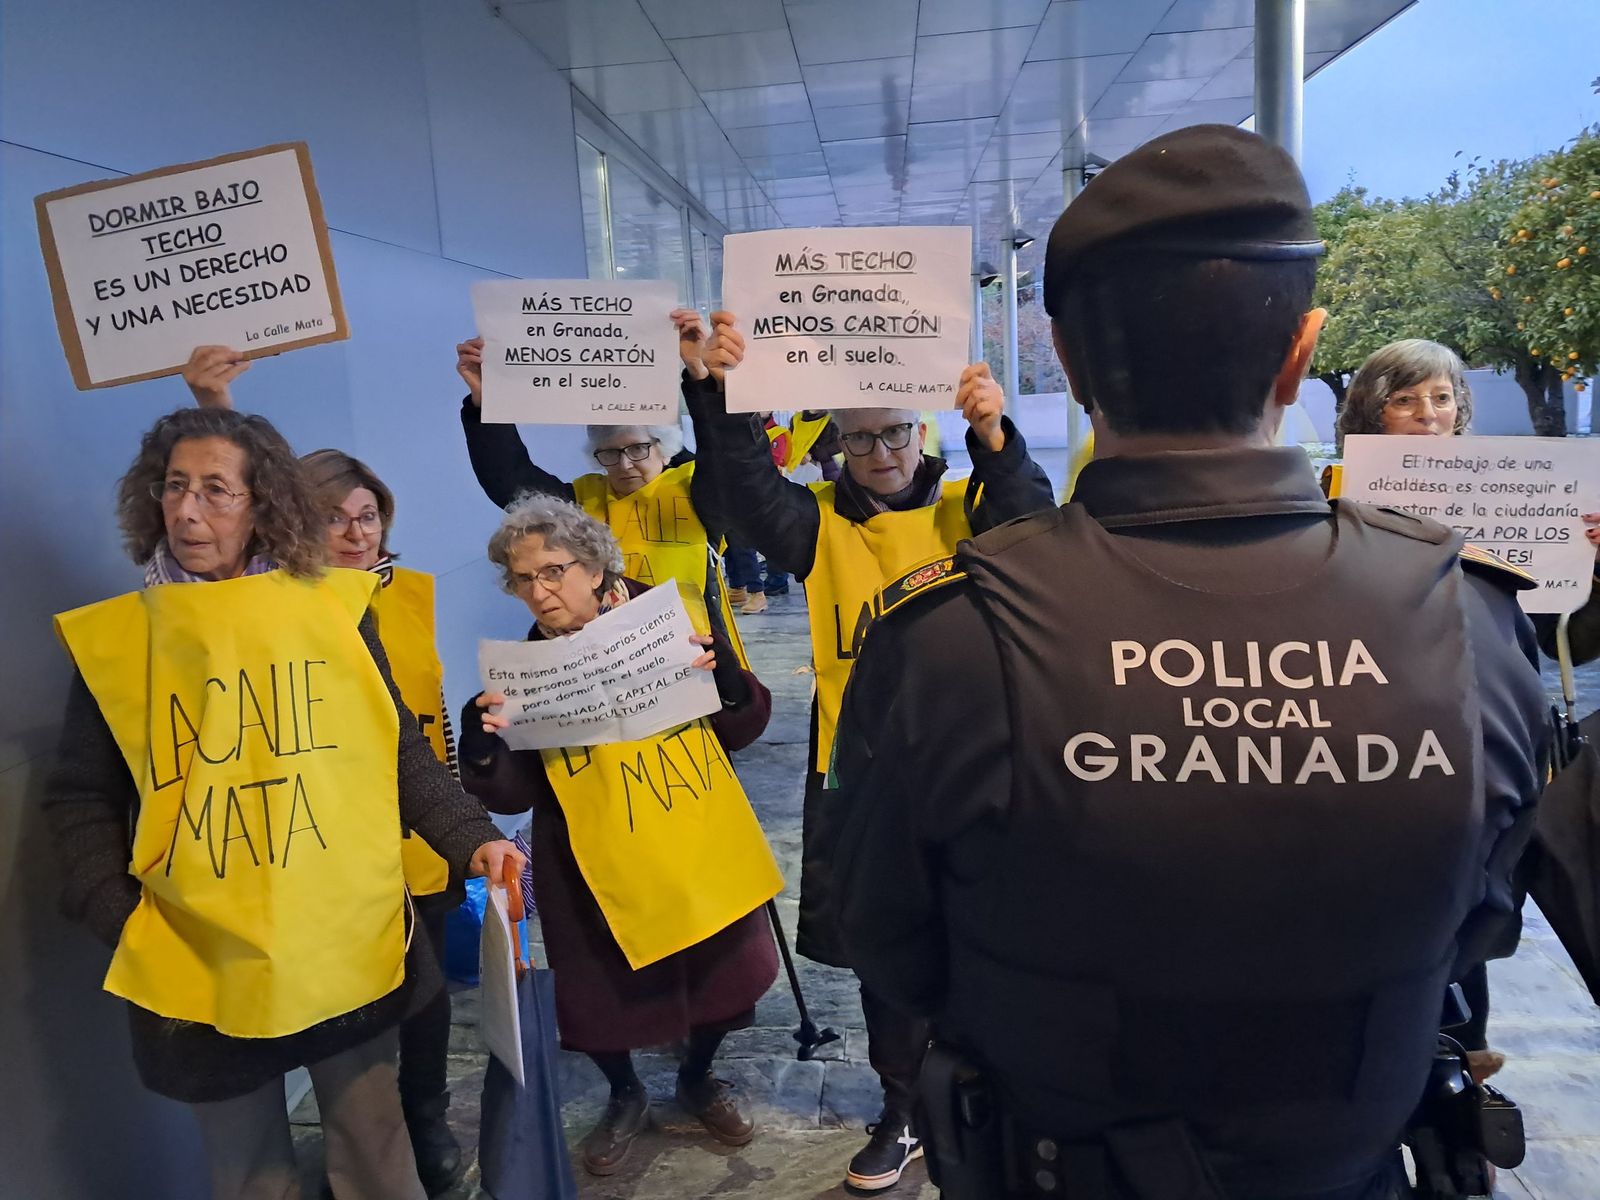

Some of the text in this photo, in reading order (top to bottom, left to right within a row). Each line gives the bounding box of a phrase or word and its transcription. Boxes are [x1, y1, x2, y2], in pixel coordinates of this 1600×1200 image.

[88, 180, 260, 233] DORMIR BAJO
[141, 222, 222, 255] TECHO
[775, 246, 915, 272] MÁS TECHO
[94, 243, 288, 301] ES UN DERECHO
[86, 274, 311, 336] Y UNA NECESIDAD
[522, 292, 633, 312] MÁS TECHO
[779, 290, 802, 303] en
[246, 317, 323, 342] La Calle Mata
[526, 322, 628, 340] en Granada,
[753, 310, 939, 335] MENOS CARTÓN
[505, 344, 654, 363] MENOS CARTÓN
[786, 345, 902, 365] en el suelo.
[533, 373, 627, 389] en el suelo.
[859, 381, 953, 393] LA CALLE MATA
[591, 403, 667, 412] LA CALLE MATA
[1427, 455, 1489, 473] trabajo
[1497, 456, 1517, 470] de
[1524, 459, 1554, 470] una
[1369, 477, 1578, 498] alcaldesa es conseguir el
[617, 496, 691, 545] ALLE
[1445, 502, 1463, 517] de
[1472, 502, 1486, 517] la
[1495, 502, 1579, 518] ciudadanía
[1493, 526, 1528, 540] POR
[1535, 526, 1570, 541] LOS
[1544, 580, 1578, 589] MATA
[489, 608, 676, 681] Esta misma noche varios cientos
[503, 629, 675, 697] de personas buscan cartones
[1110, 638, 1389, 689] POLICIA
[522, 699, 551, 713] para
[555, 684, 596, 702] dormir
[601, 677, 616, 686] en
[621, 670, 632, 680] el
[616, 676, 670, 703] CAPITAL
[675, 666, 692, 681] DE
[1182, 697, 1332, 728] LOCAL
[1063, 730, 1455, 784] GRANADA
[621, 718, 733, 833] MATA
[165, 773, 327, 879] MATA
